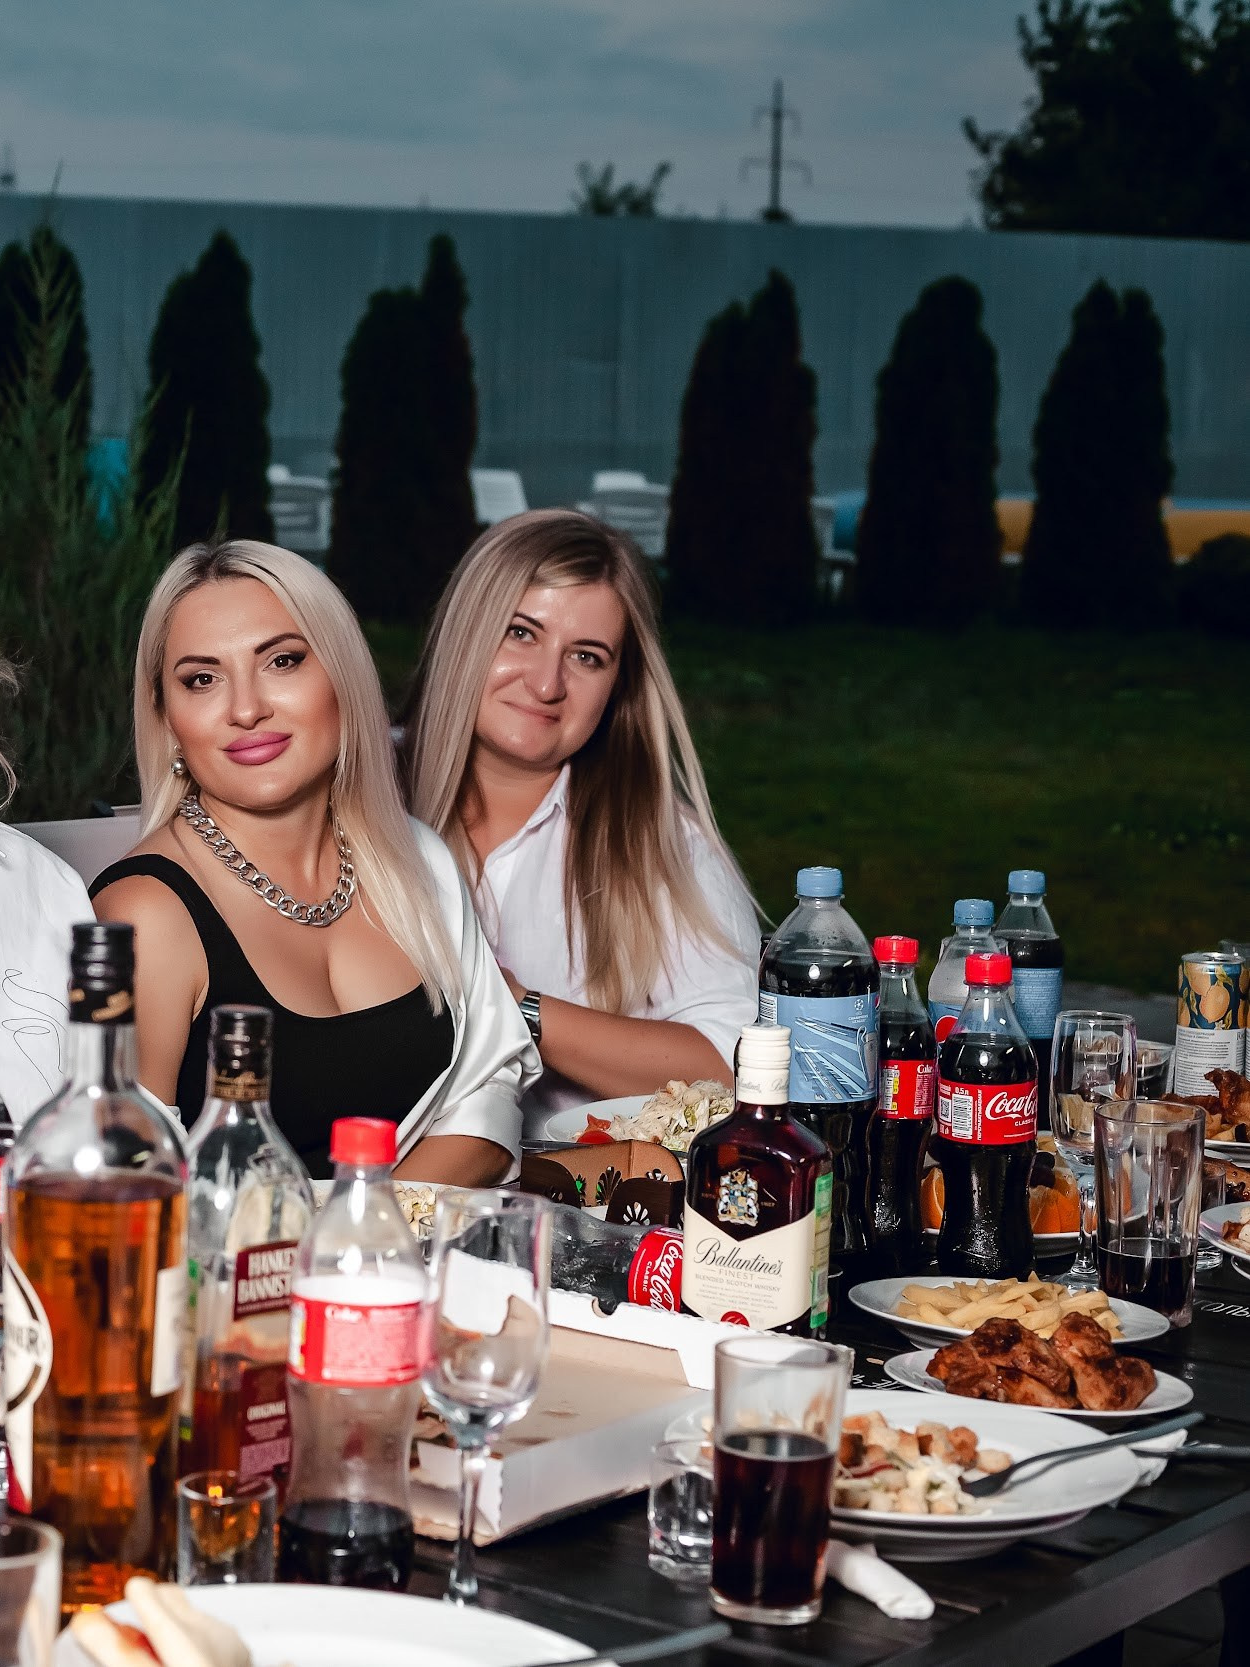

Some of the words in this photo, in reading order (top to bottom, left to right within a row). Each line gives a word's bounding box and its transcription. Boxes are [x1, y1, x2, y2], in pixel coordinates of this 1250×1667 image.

[985, 1085, 1038, 1121] Coca-Co
[693, 1237, 784, 1276] Ballantine's
[642, 1260, 652, 1292] CLASSIC
[650, 1240, 684, 1310] oca-Co
[718, 1268, 755, 1281] FINEST
[726, 1278, 753, 1289] SCOTCH
